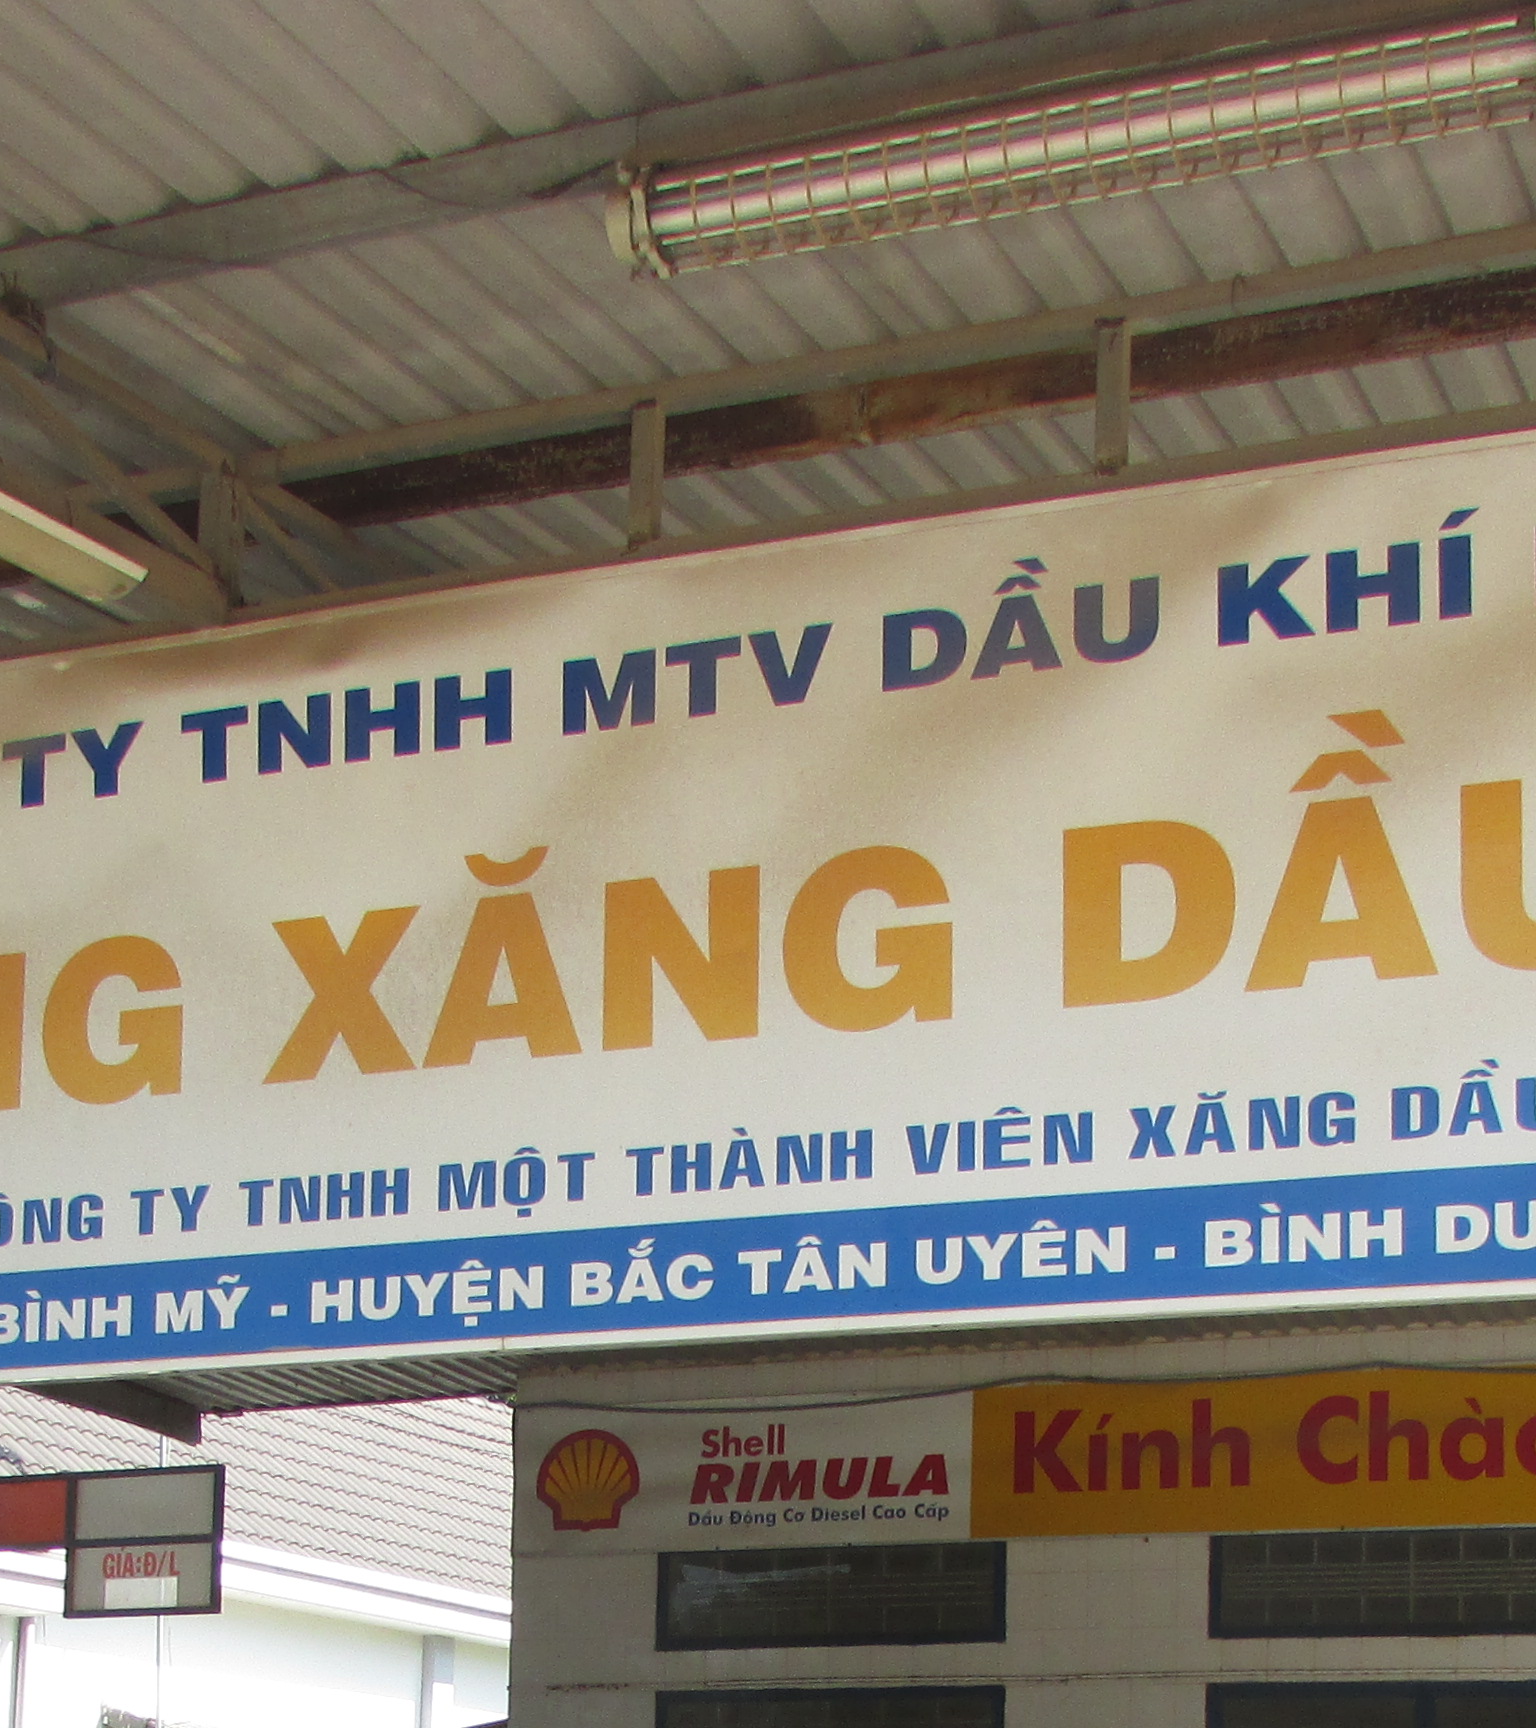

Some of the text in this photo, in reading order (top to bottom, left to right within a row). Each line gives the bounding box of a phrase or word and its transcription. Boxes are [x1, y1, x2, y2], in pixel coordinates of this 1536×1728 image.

[2, 721, 142, 807] TY
[181, 669, 512, 782] TNHH
[563, 623, 832, 734] MTV
[882, 557, 1159, 691] DẦU
[1218, 508, 1478, 644] KHÍ
[265, 845, 952, 1083] XĂNG
[131, 1185, 209, 1235] TY
[239, 1168, 409, 1226] TNHH
[438, 1147, 595, 1217] MỘT
[626, 1127, 872, 1195] THÀNH
[906, 1107, 1092, 1173] VIÊN
[1130, 1091, 1355, 1158] XĂNG
[155, 1274, 249, 1333] MỸ
[311, 1260, 543, 1326] HUYỆN
[571, 1236, 713, 1306] BẮC
[738, 1236, 886, 1294] TÂN
[916, 1220, 1125, 1284] UYÊN
[1205, 1203, 1402, 1266] BÌNH
[690, 1454, 950, 1504] RIMULA
[700, 1424, 786, 1458] Shell
[1013, 1399, 1250, 1493] Kính
[811, 1505, 865, 1522] Diesel
[873, 1503, 907, 1519] Cao
